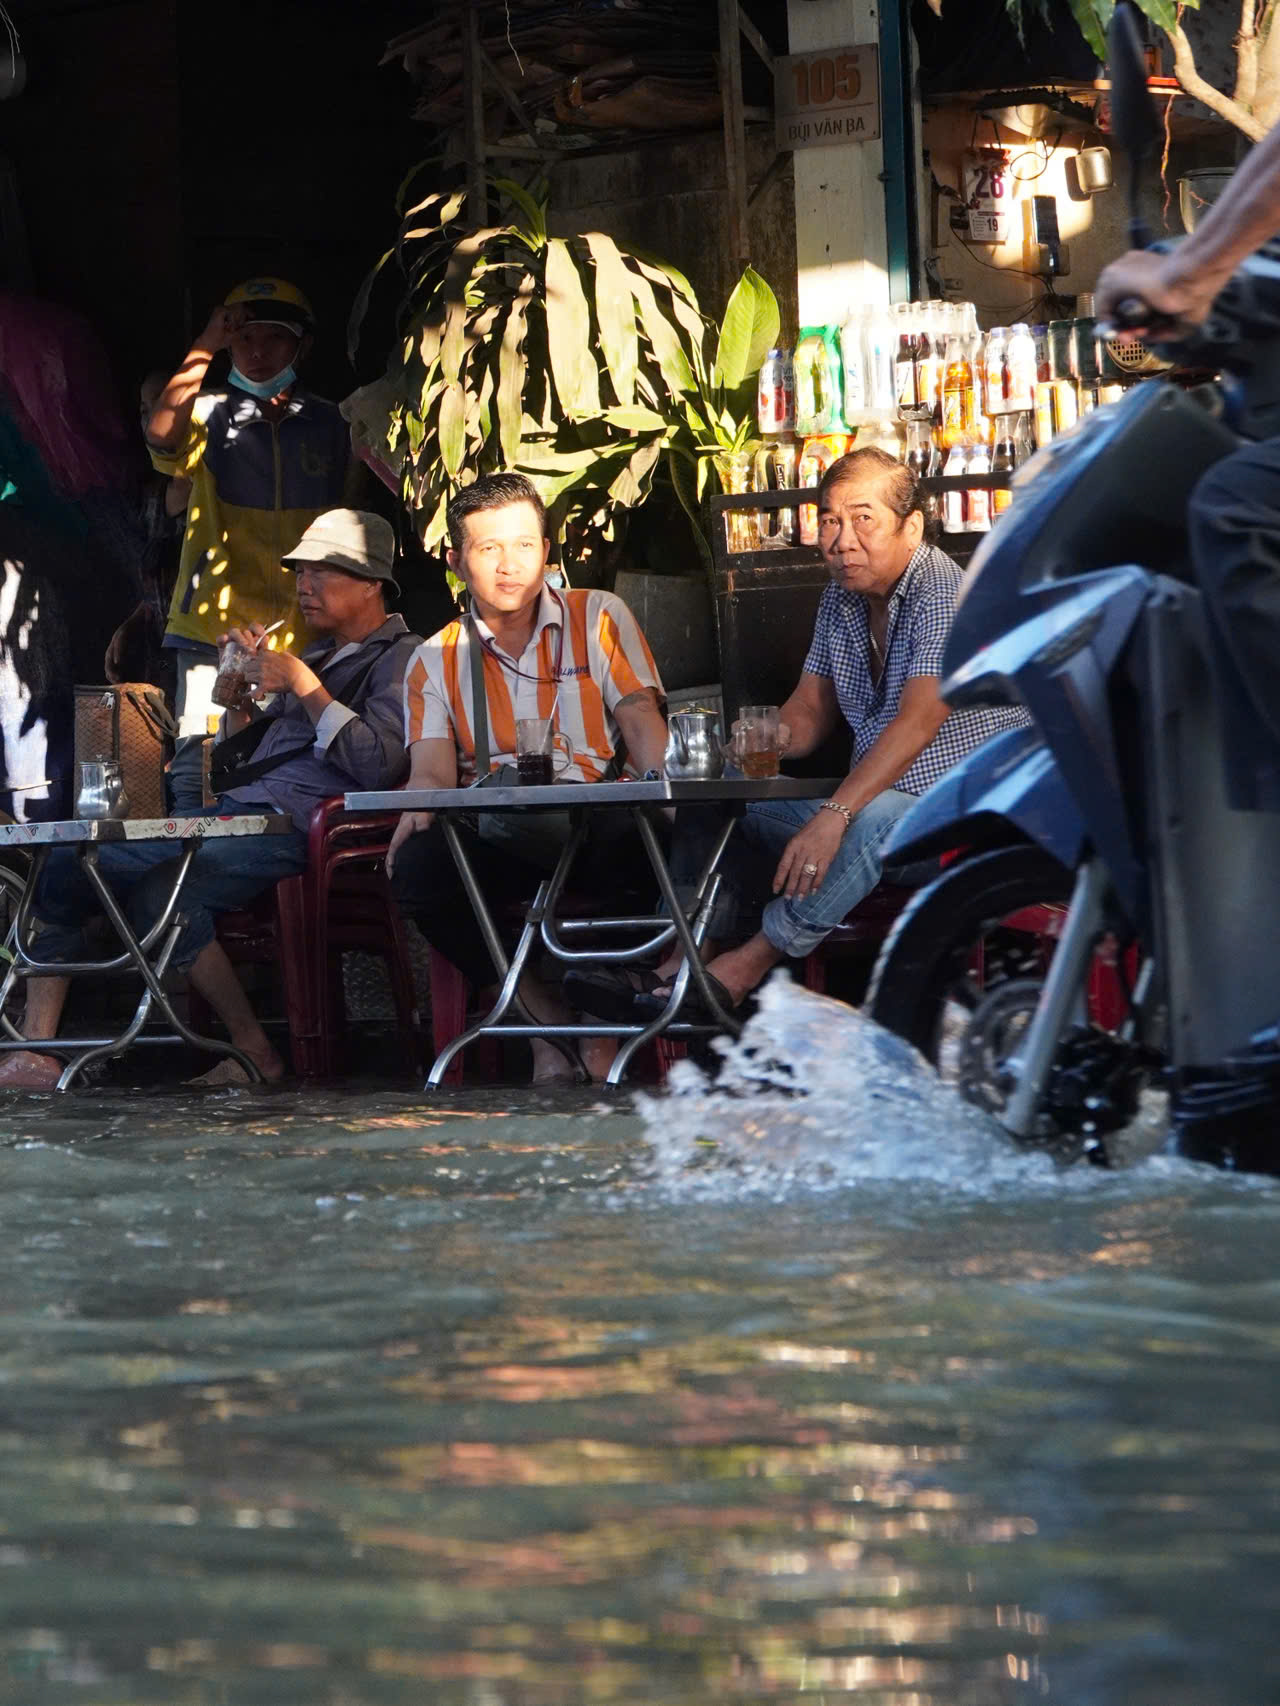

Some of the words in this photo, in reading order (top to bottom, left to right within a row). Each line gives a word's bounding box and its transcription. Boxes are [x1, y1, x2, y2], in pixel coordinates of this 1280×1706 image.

[790, 55, 861, 105] 105
[814, 117, 842, 136] VĂN
[846, 116, 865, 136] BA
